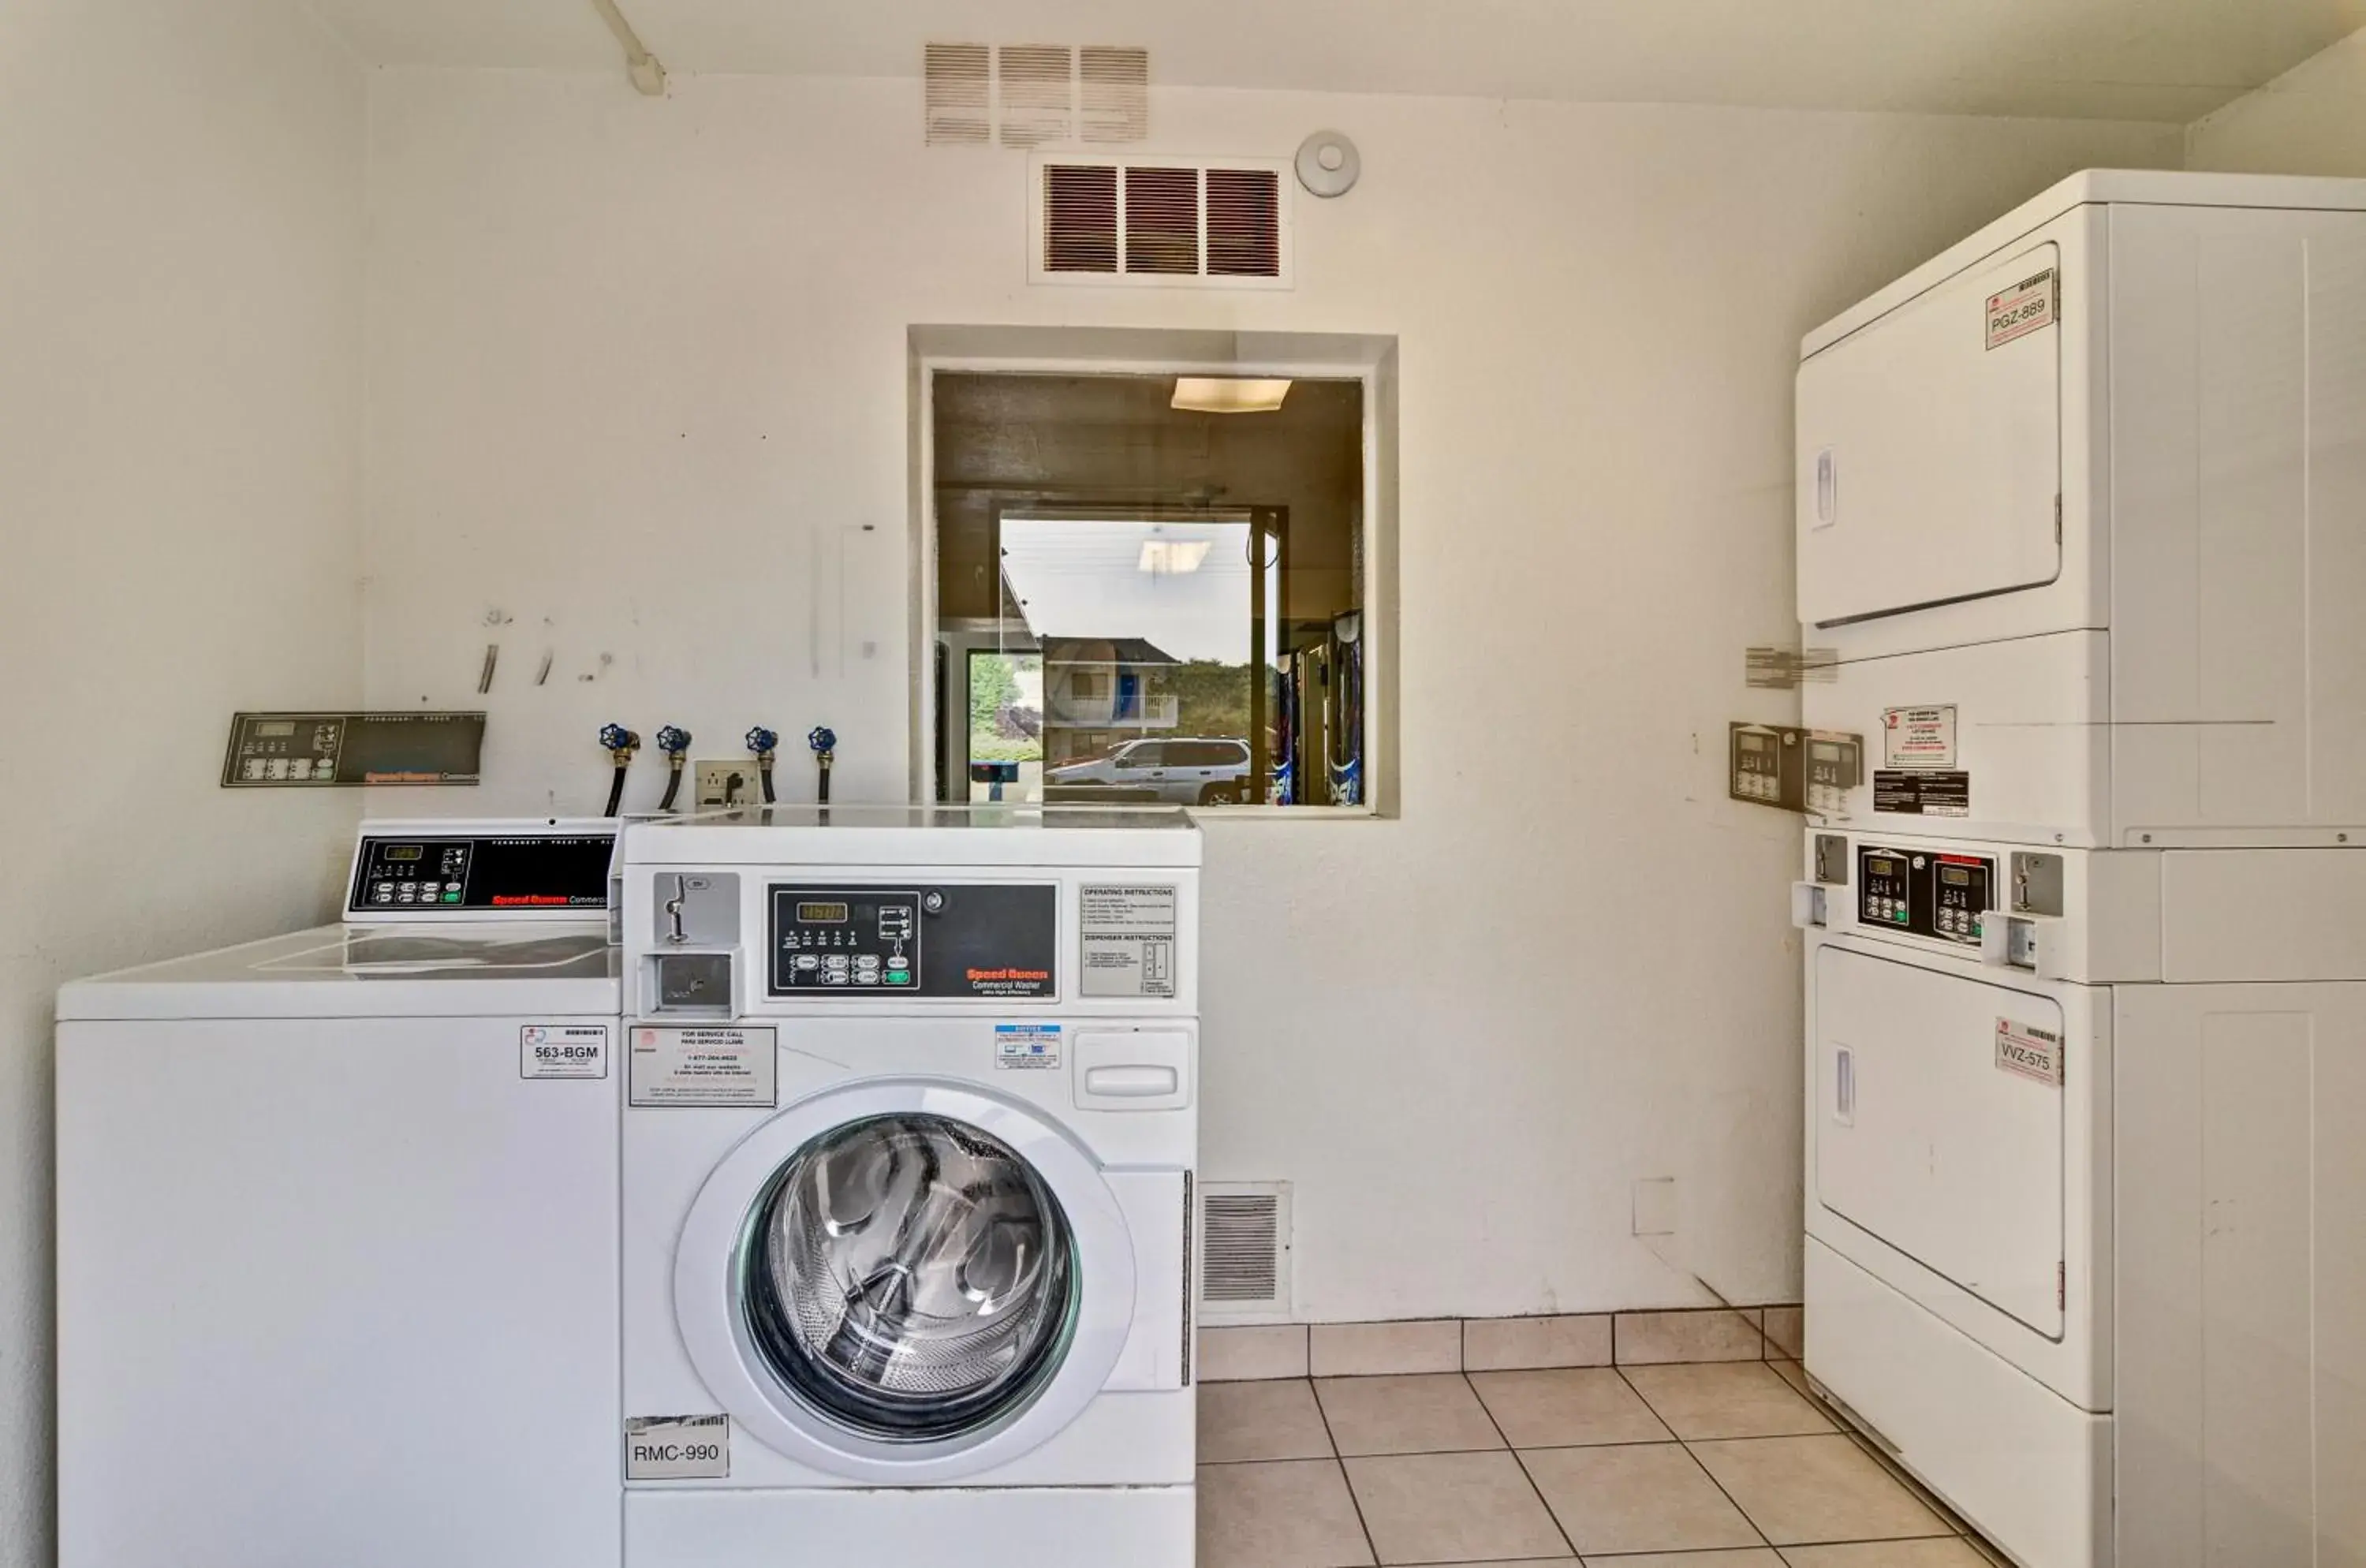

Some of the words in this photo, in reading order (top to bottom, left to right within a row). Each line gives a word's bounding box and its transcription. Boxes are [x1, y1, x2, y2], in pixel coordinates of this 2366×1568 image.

[1992, 298, 2045, 332] PGZ-889
[492, 895, 529, 905] Speed
[531, 895, 567, 904] Queen
[967, 968, 1007, 980] Speed
[1009, 968, 1048, 979] Queen
[972, 980, 1013, 990] Commercial
[1015, 980, 1040, 989] Washer
[536, 1046, 599, 1058] 563-BGM
[2001, 1043, 2051, 1070] VVZ-575
[634, 1444, 719, 1462] RMC-990
